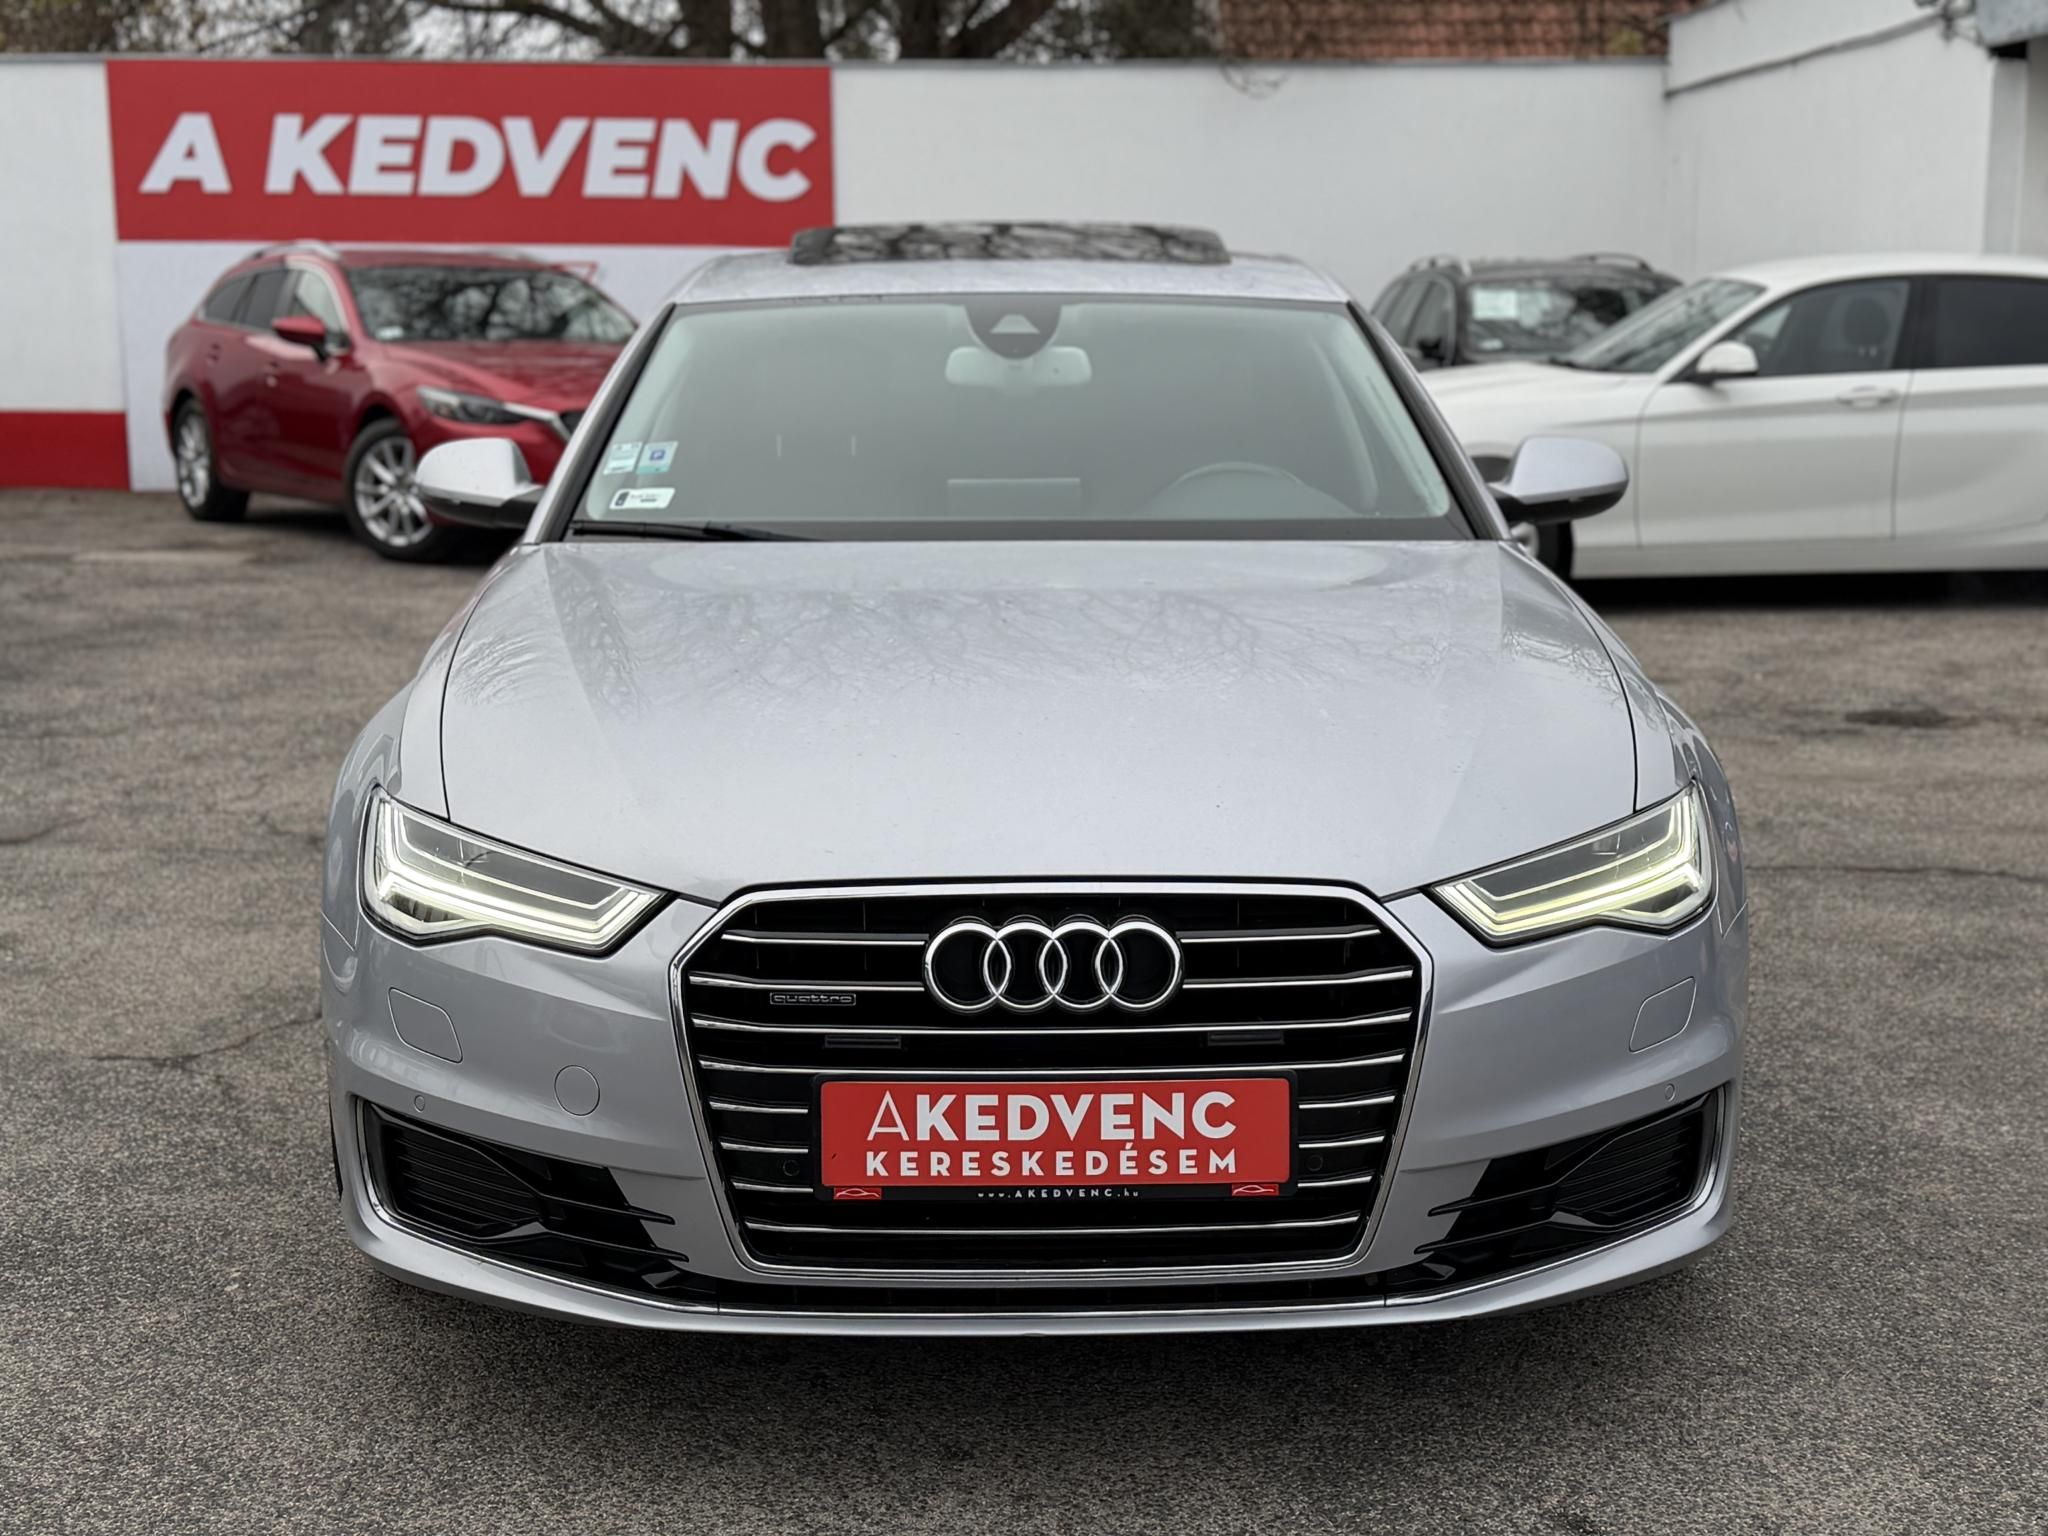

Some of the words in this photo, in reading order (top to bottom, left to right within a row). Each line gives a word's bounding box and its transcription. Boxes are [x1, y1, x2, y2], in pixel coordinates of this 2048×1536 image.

[139, 112, 231, 193] A
[264, 112, 816, 201] KEDVENC
[773, 994, 852, 1004] quattro
[866, 1142, 1236, 1176] KERESKEDÉSEM
[978, 1188, 1139, 1198] www.AKEDVENC.hu
